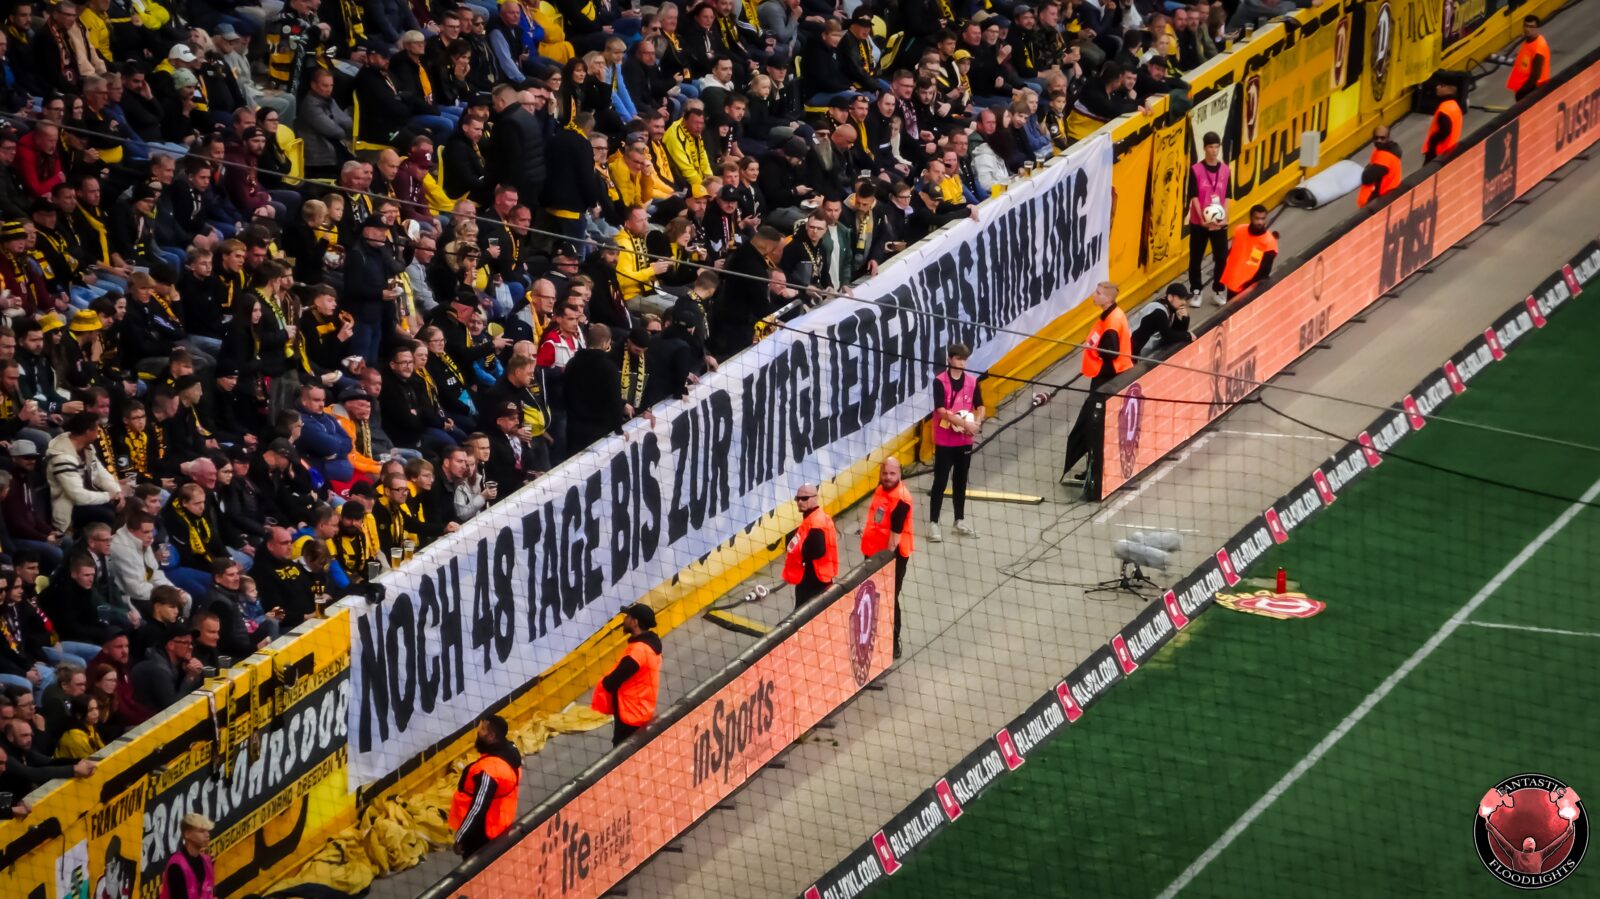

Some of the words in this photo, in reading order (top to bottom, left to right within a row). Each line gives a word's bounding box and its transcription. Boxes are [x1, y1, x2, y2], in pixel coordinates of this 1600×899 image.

[358, 556, 465, 754] NOCH
[472, 526, 515, 675] 48
[522, 469, 604, 643] TAGE
[611, 431, 662, 587] BIS
[668, 388, 733, 546] ZUR
[693, 674, 775, 789] inSports
[91, 781, 145, 841] FRAKTION
[889, 801, 945, 860] ALL-INKL.COM
